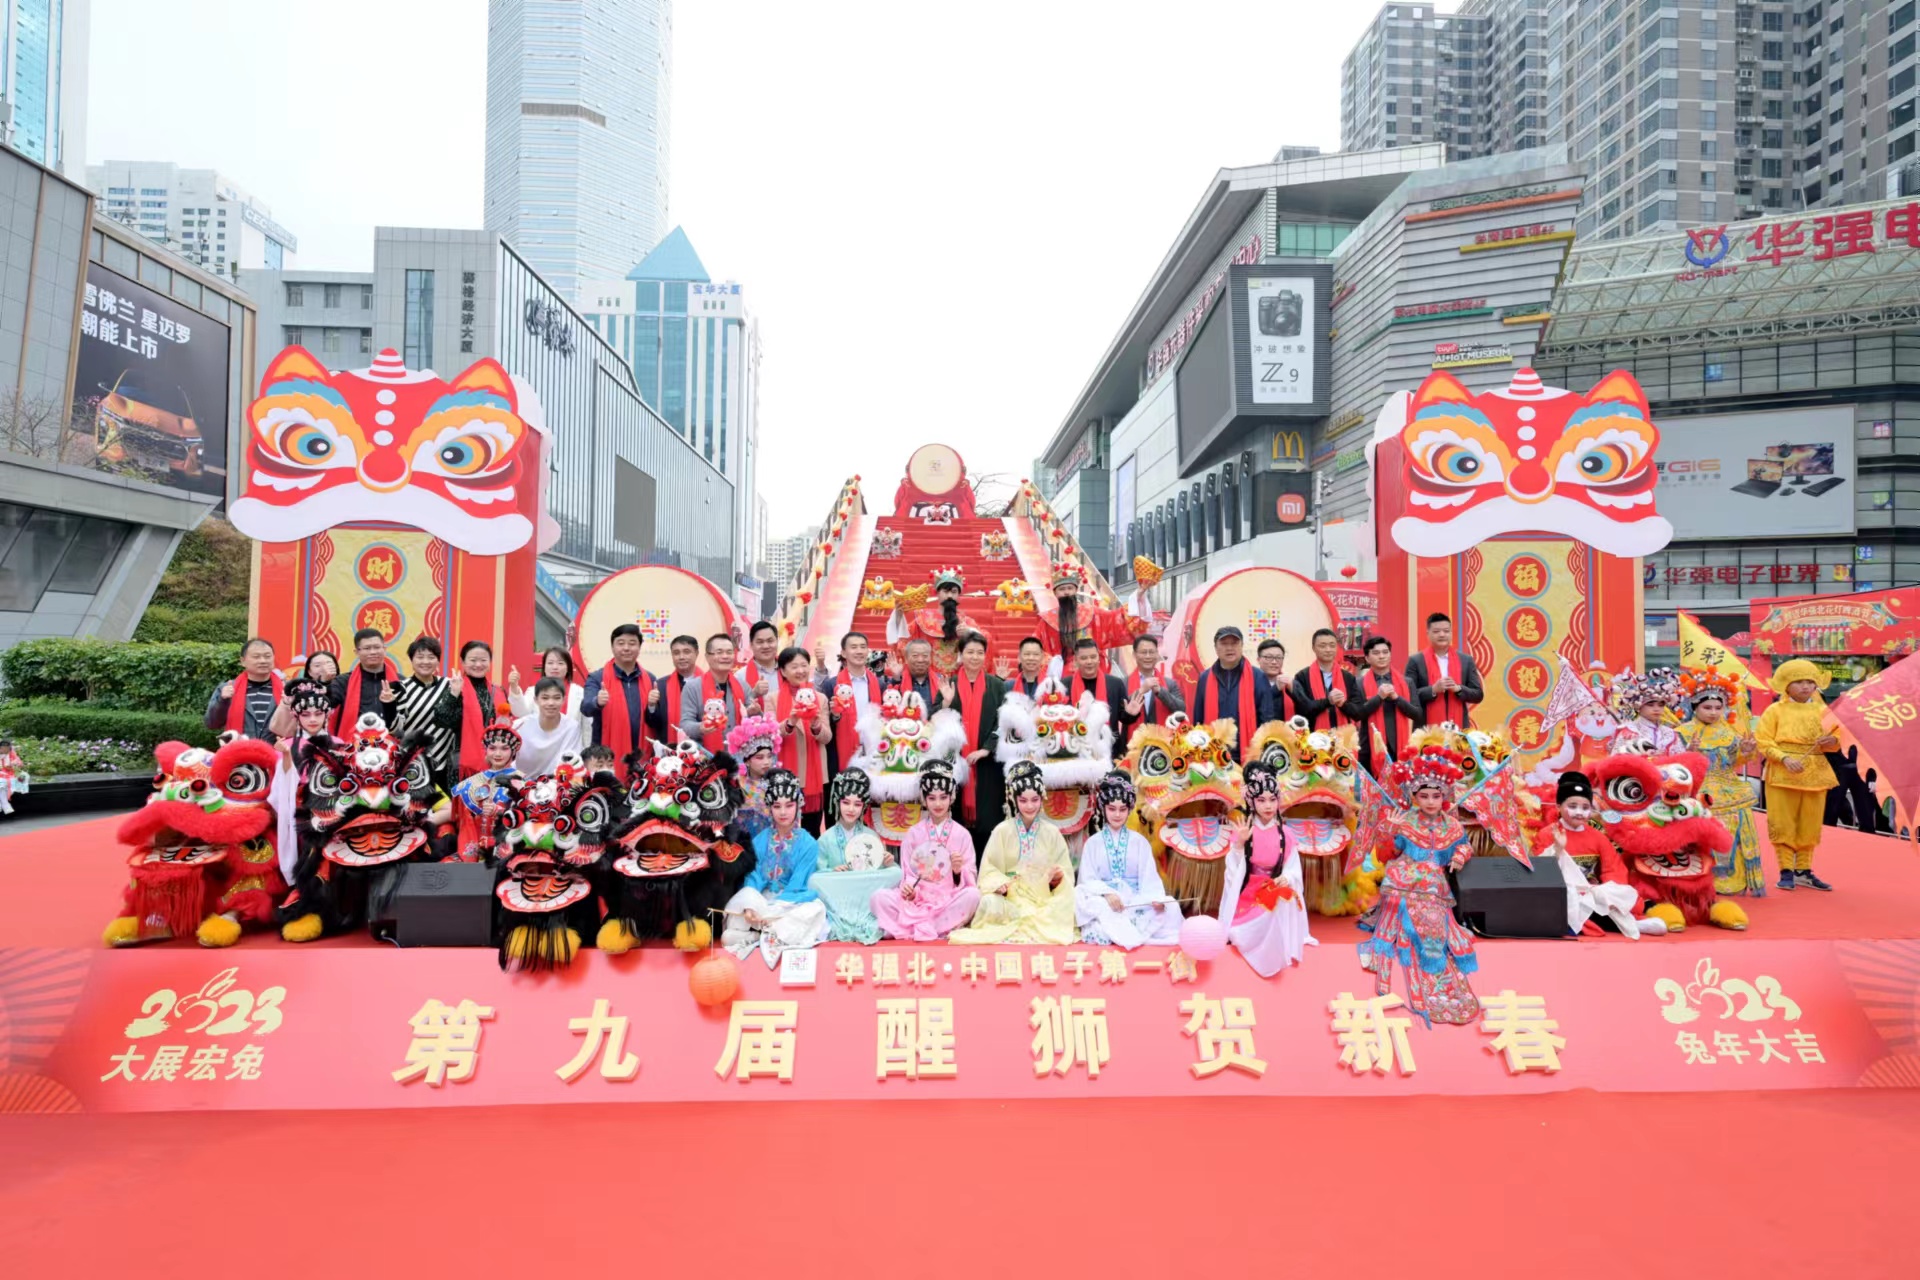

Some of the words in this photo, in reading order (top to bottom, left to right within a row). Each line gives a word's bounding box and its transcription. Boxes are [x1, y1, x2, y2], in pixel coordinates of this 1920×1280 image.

[693, 284, 740, 295] 宝华大厦
[83, 281, 136, 324] 雪佛兰
[140, 308, 191, 344] 星迈罗
[1468, 348, 1511, 359] MUSEUM
[1663, 564, 1822, 586] 华强电子世界
[1674, 1030, 1826, 1065] 兔年大吉
[100, 1044, 264, 1083] 大展宏兔
